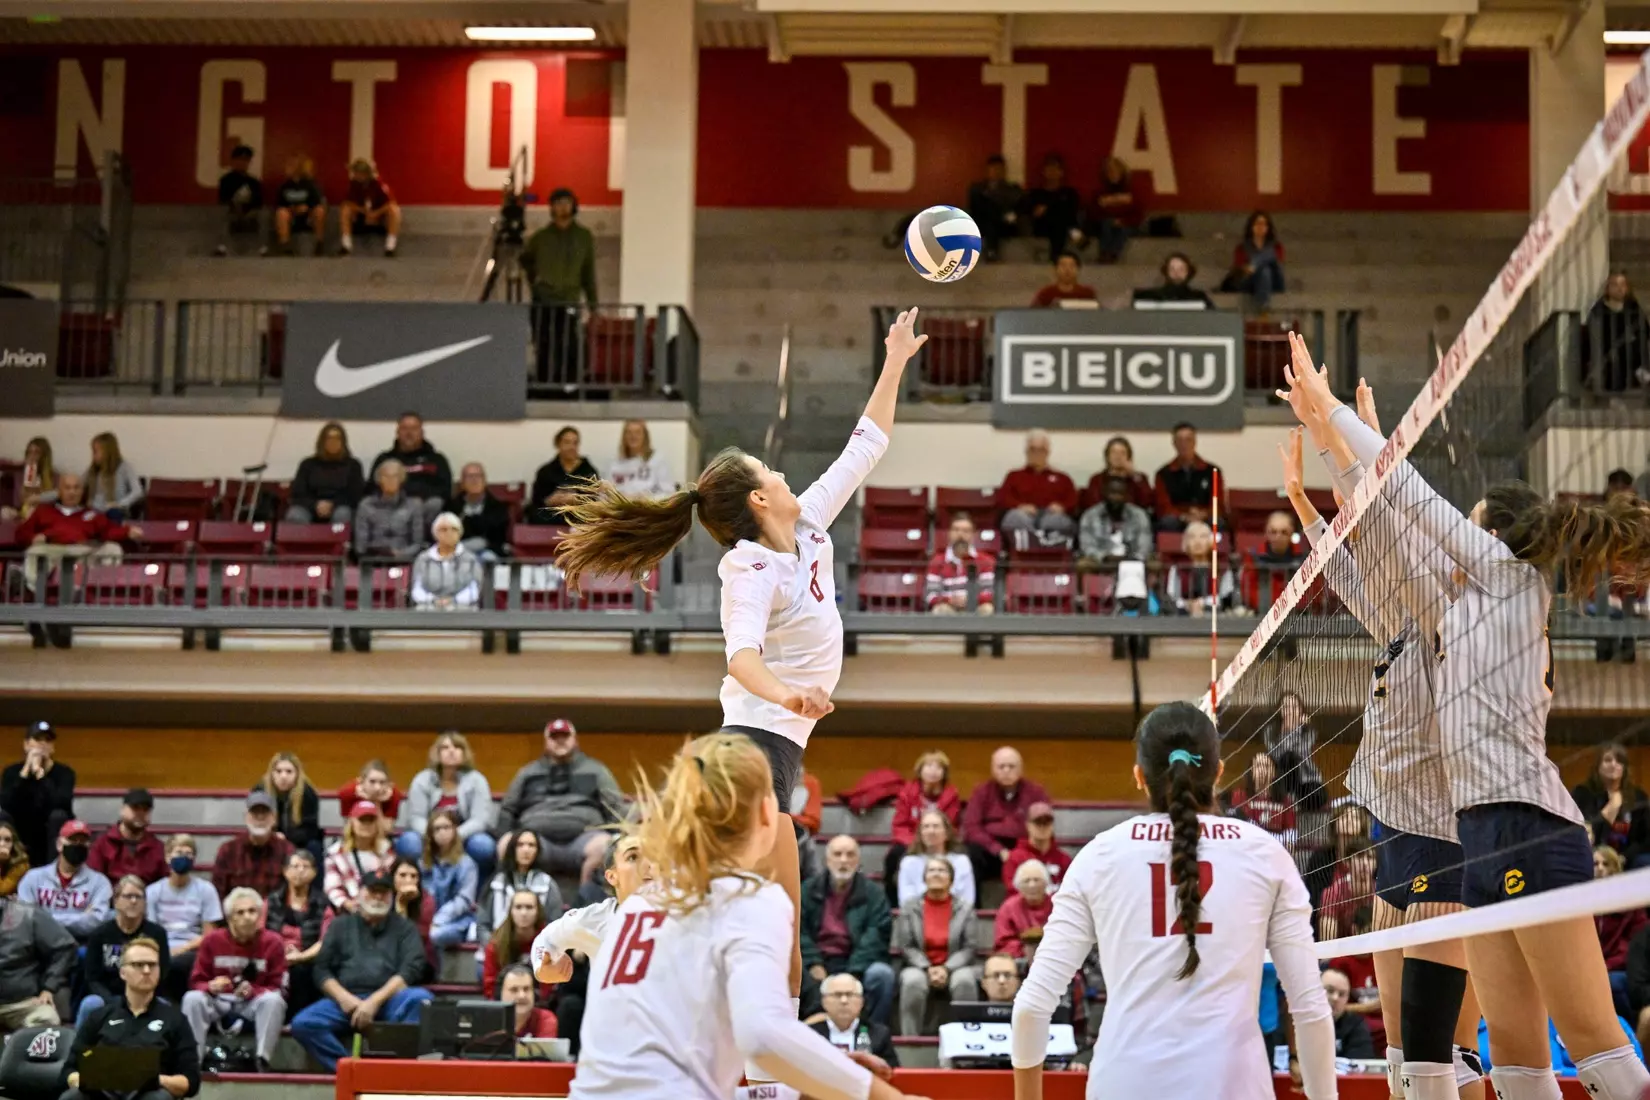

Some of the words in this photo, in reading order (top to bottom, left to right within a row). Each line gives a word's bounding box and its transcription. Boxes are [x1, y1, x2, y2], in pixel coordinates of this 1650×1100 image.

[843, 61, 1432, 194] STATE
[1131, 822, 1241, 841] COUARS
[37, 888, 89, 910] WSU
[1147, 861, 1213, 937] 12
[601, 910, 669, 990] 16
[748, 1086, 778, 1099] WSU
